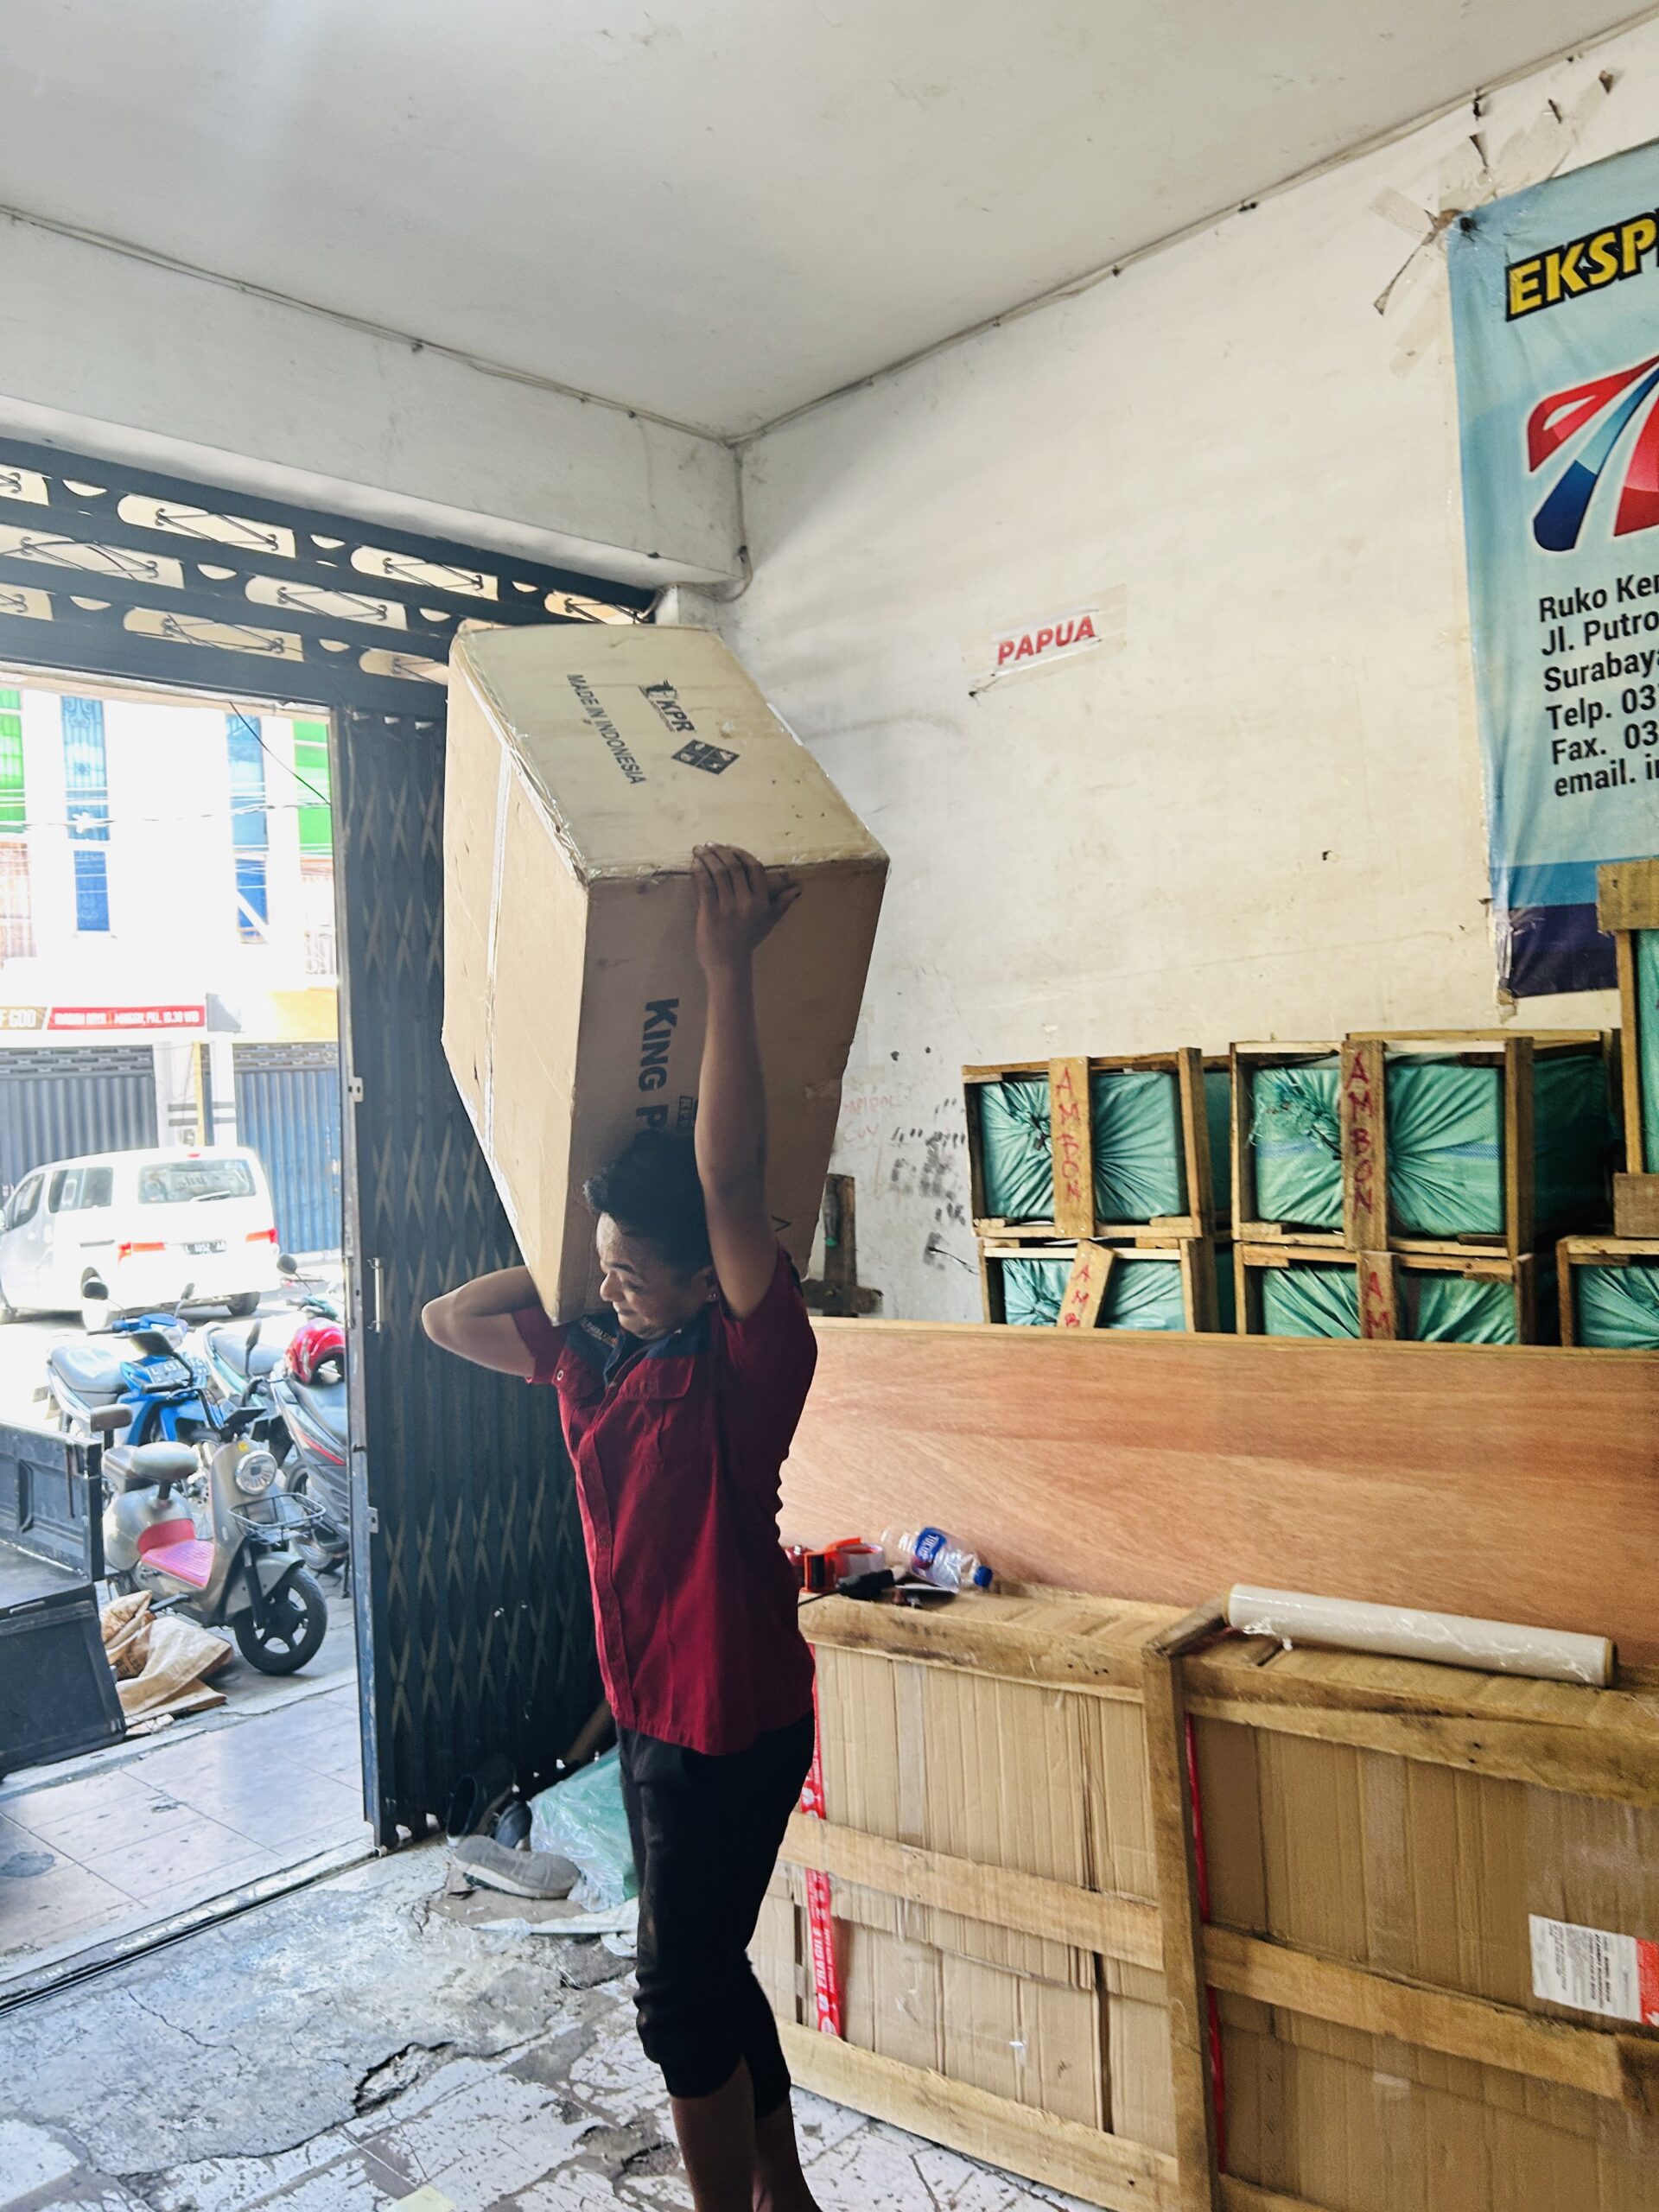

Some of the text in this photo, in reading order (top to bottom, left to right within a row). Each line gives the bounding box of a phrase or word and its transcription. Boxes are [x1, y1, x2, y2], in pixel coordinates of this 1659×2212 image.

[1504, 209, 1659, 322] EKSP
[1538, 587, 1608, 623] Ruko
[997, 614, 1096, 666] PAPUA
[1541, 610, 1659, 657] Jl. Putro
[1544, 649, 1659, 692] Surabay
[566, 673, 647, 785] MADE IN INDONESIA
[1545, 683, 1659, 731] Telp. 03
[1551, 720, 1659, 766] Fax. 03
[1554, 757, 1637, 798] email.
[635, 997, 680, 1130] KING P
[1343, 1051, 1376, 1221] AMBON
[812, 1925, 827, 1990] FRAGILE
